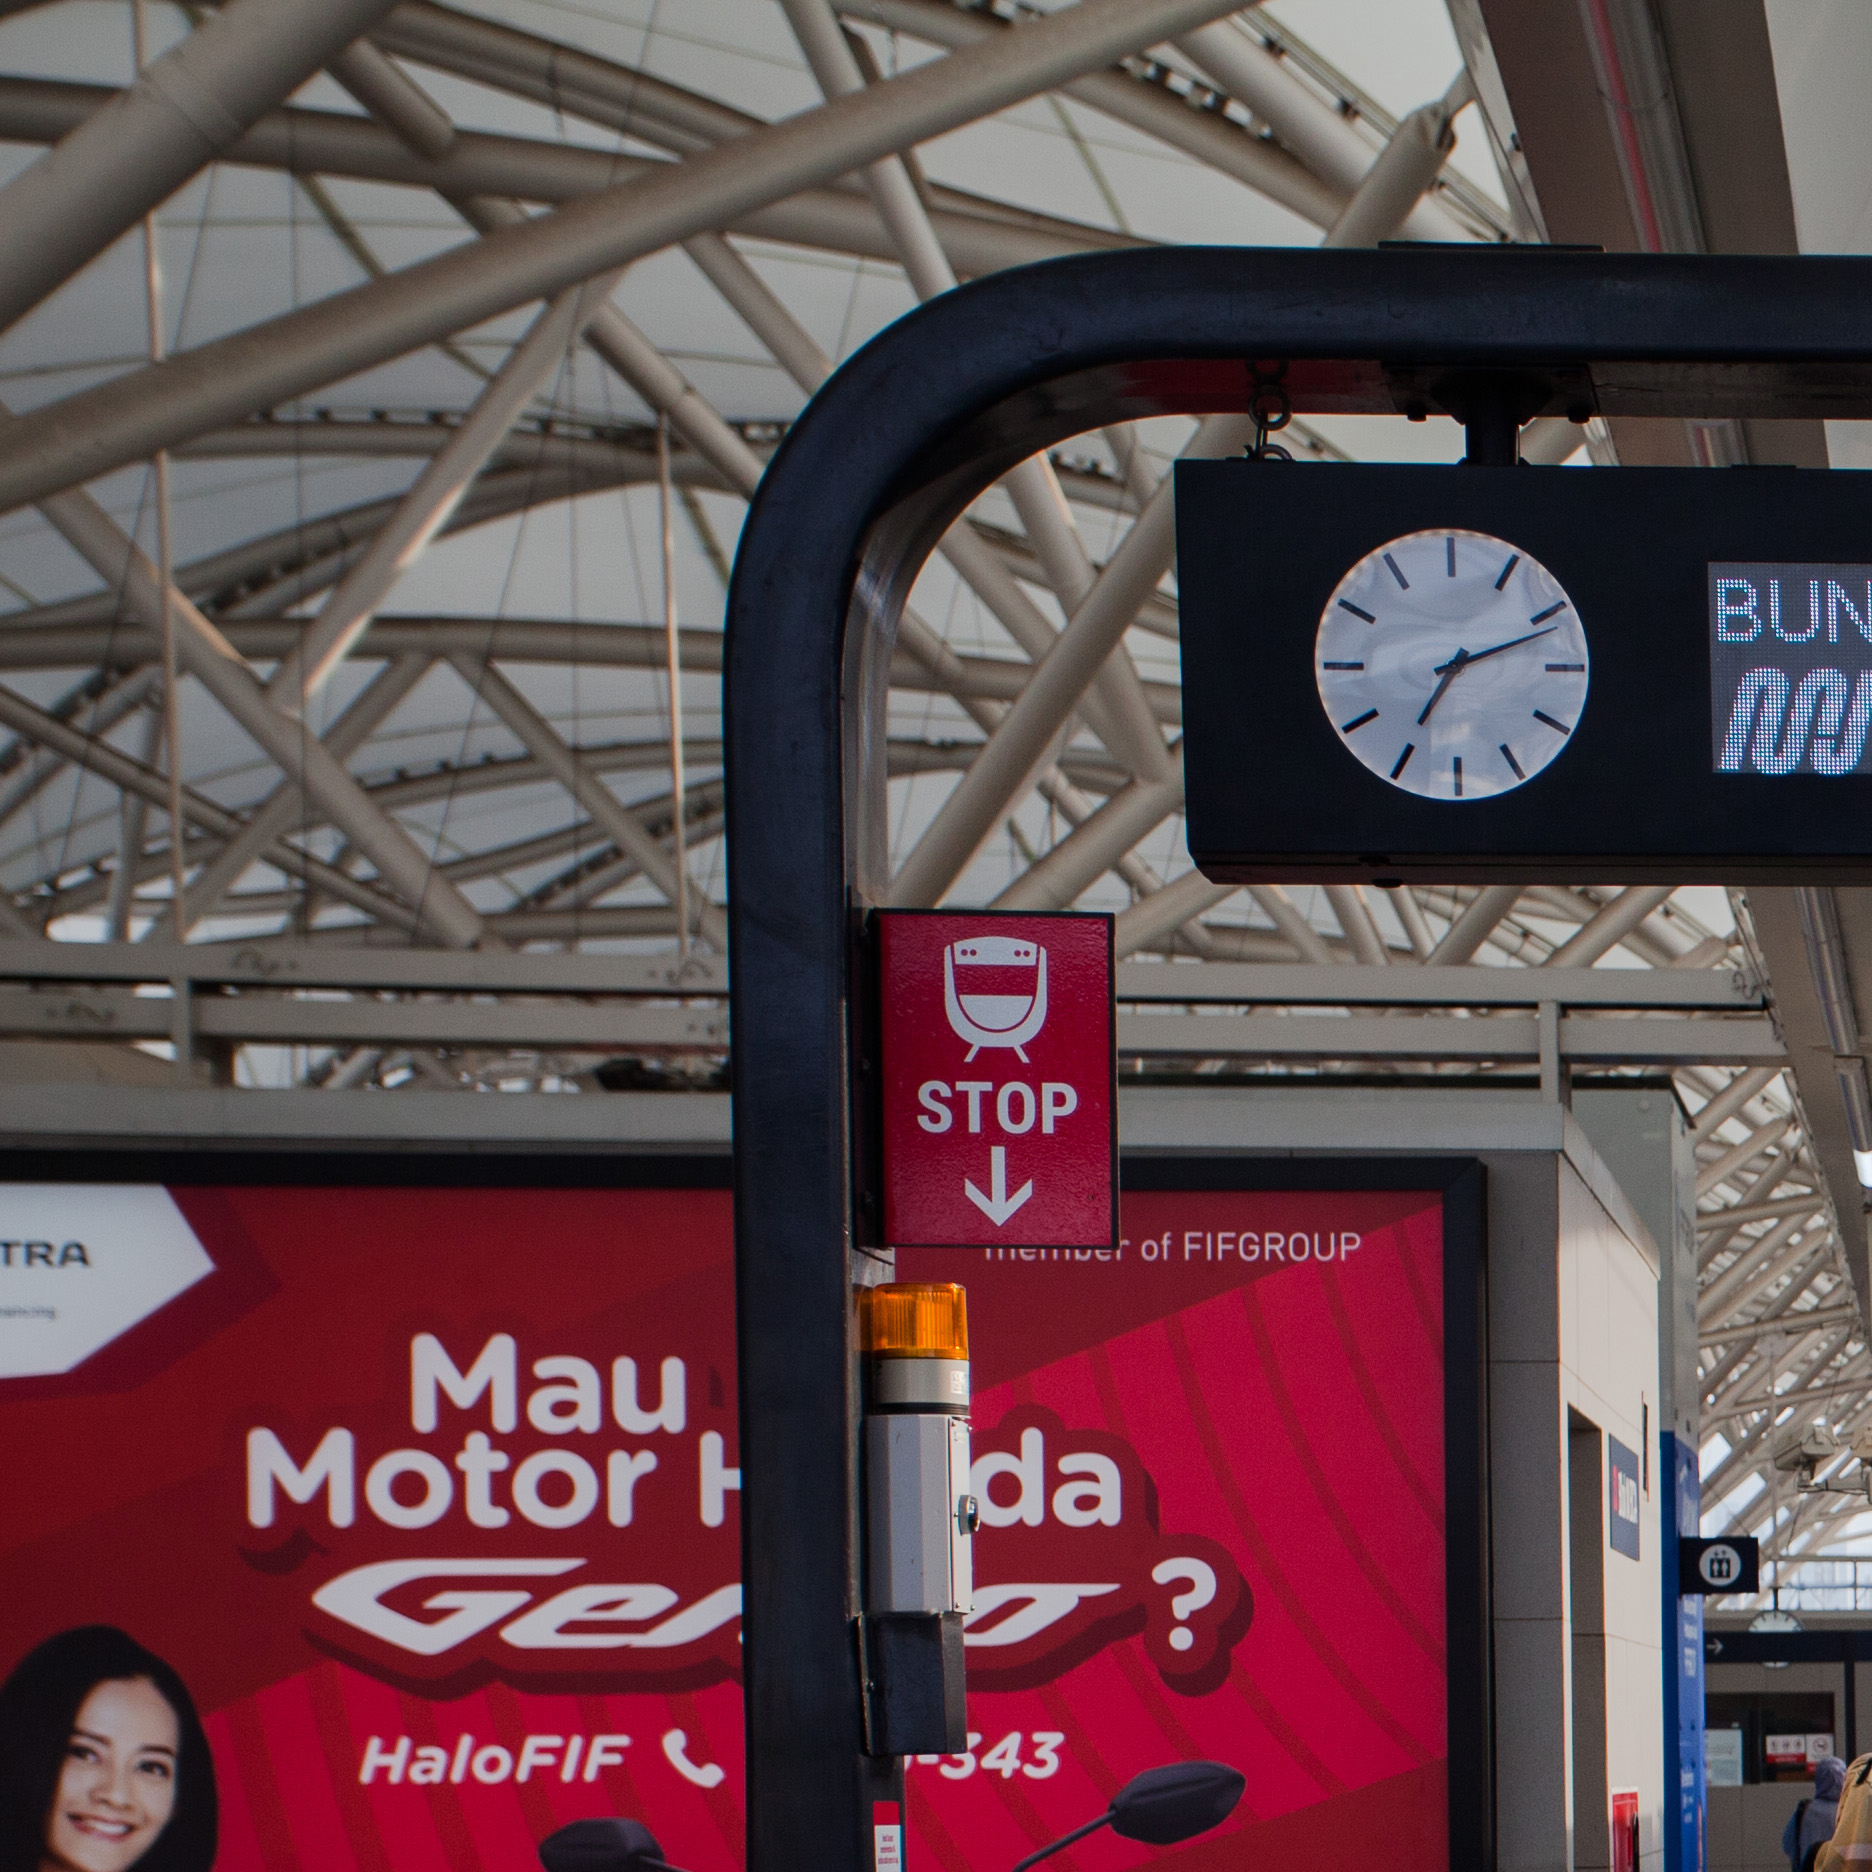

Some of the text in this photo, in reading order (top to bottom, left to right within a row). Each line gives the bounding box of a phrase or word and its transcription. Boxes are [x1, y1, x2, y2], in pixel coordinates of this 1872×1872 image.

[917, 1080, 1079, 1136] STOP
[1140, 1231, 1173, 1263] of
[1183, 1231, 1362, 1263] FIFGROUP
[411, 1333, 688, 1434] Mau
[246, 1426, 658, 1530] Motor
[359, 1734, 632, 1786] HaloFIF
